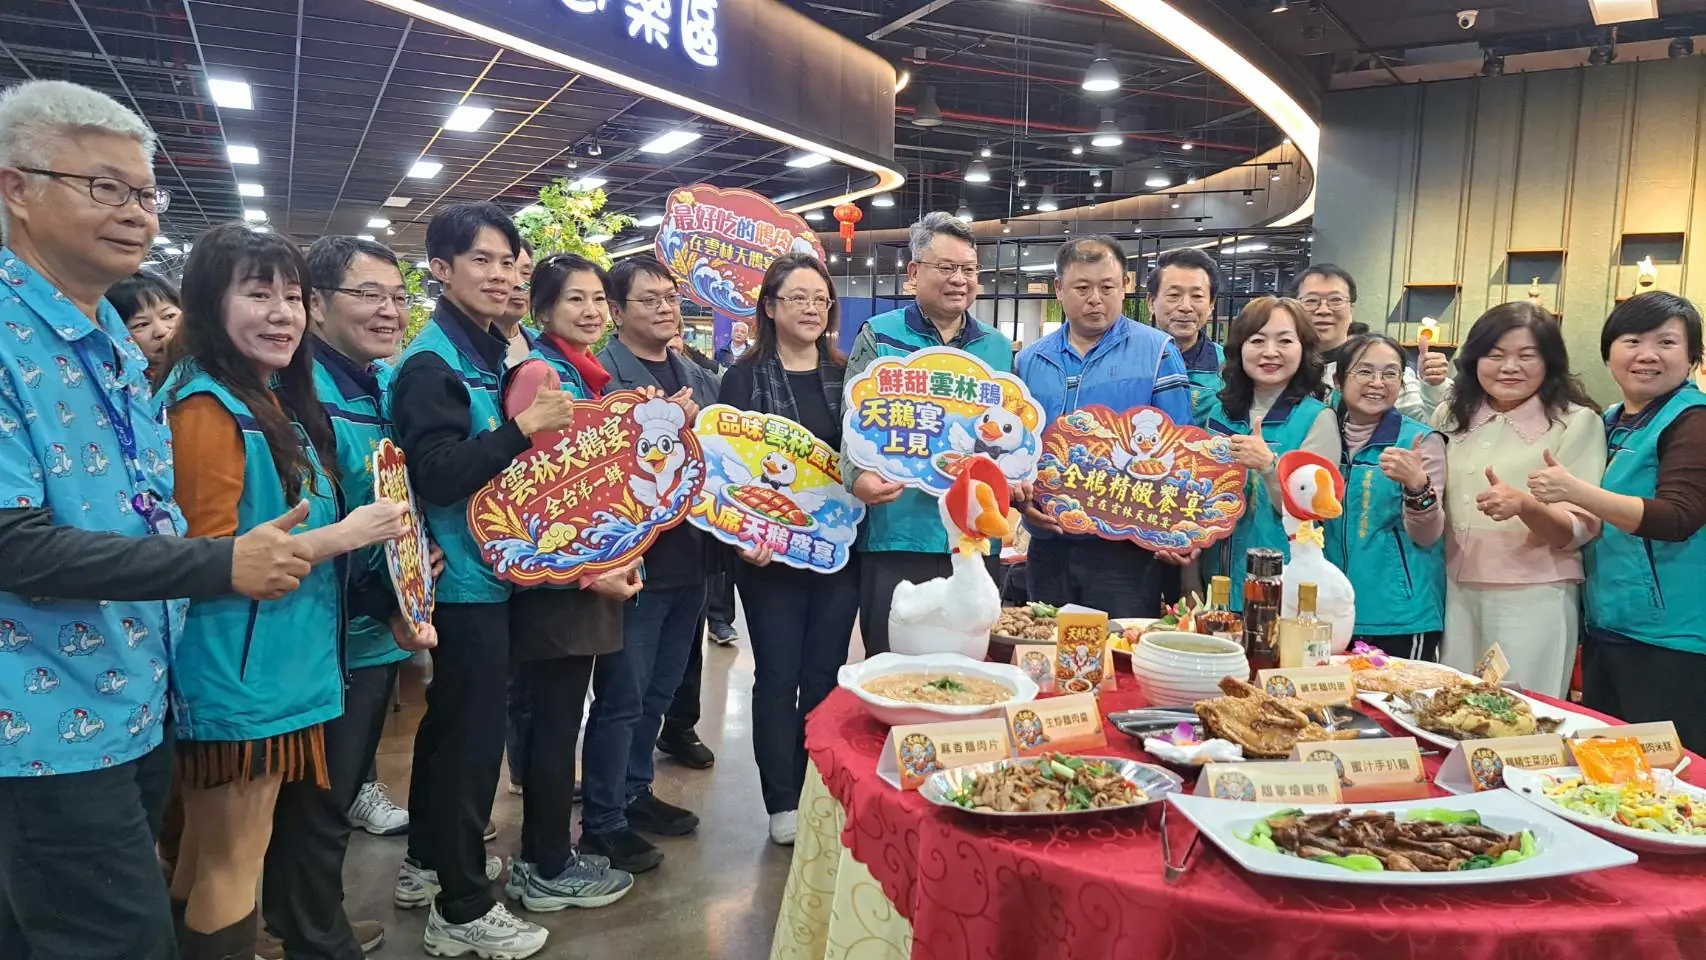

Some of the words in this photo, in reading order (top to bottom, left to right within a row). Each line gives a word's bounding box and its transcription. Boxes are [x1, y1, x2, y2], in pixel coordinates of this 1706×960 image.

[561, 0, 719, 67] 樂區
[673, 203, 793, 251] 最好吃的鵝肉
[877, 367, 1001, 406] 鮮甜雲林鵝
[861, 399, 943, 433] 天鵝宴
[884, 430, 929, 456] 上見
[500, 415, 631, 507] 雲林天鵝宴
[544, 462, 625, 520] 全台第一鮮
[1062, 463, 1205, 521] 全鵝精緻饗宴
[691, 490, 836, 570] 入席天鵝盛宴
